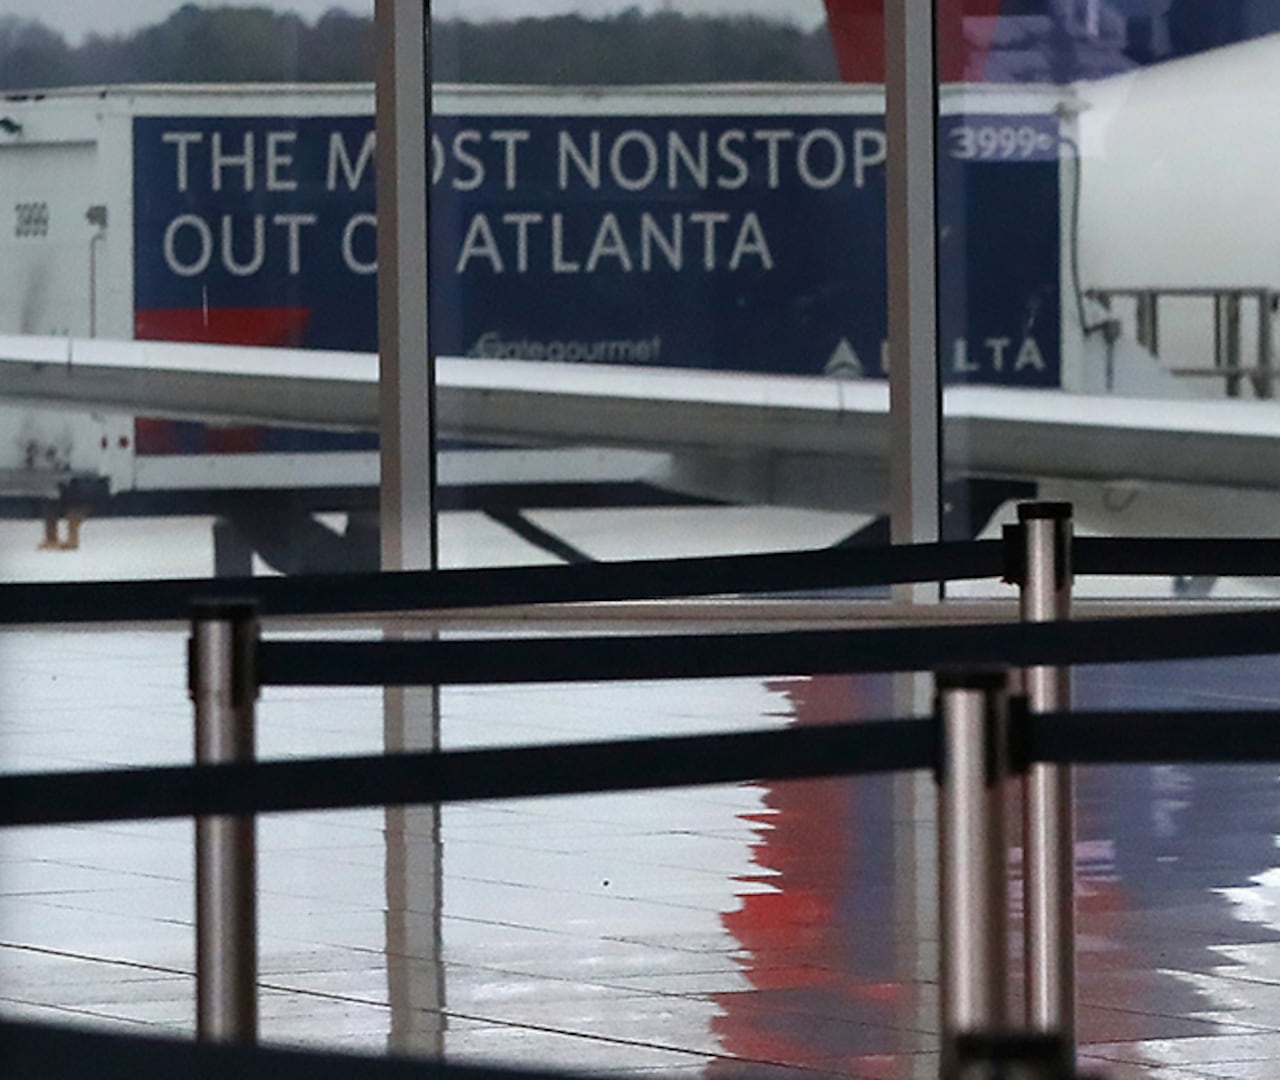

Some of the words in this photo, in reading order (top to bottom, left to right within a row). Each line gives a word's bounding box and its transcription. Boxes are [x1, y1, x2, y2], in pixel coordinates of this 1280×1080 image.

[161, 131, 298, 192] THE
[326, 130, 530, 191] MST
[558, 128, 888, 190] NONSTOP
[162, 213, 317, 277] OUT
[456, 212, 774, 274] ATLANTA
[880, 336, 1046, 372] LTA
